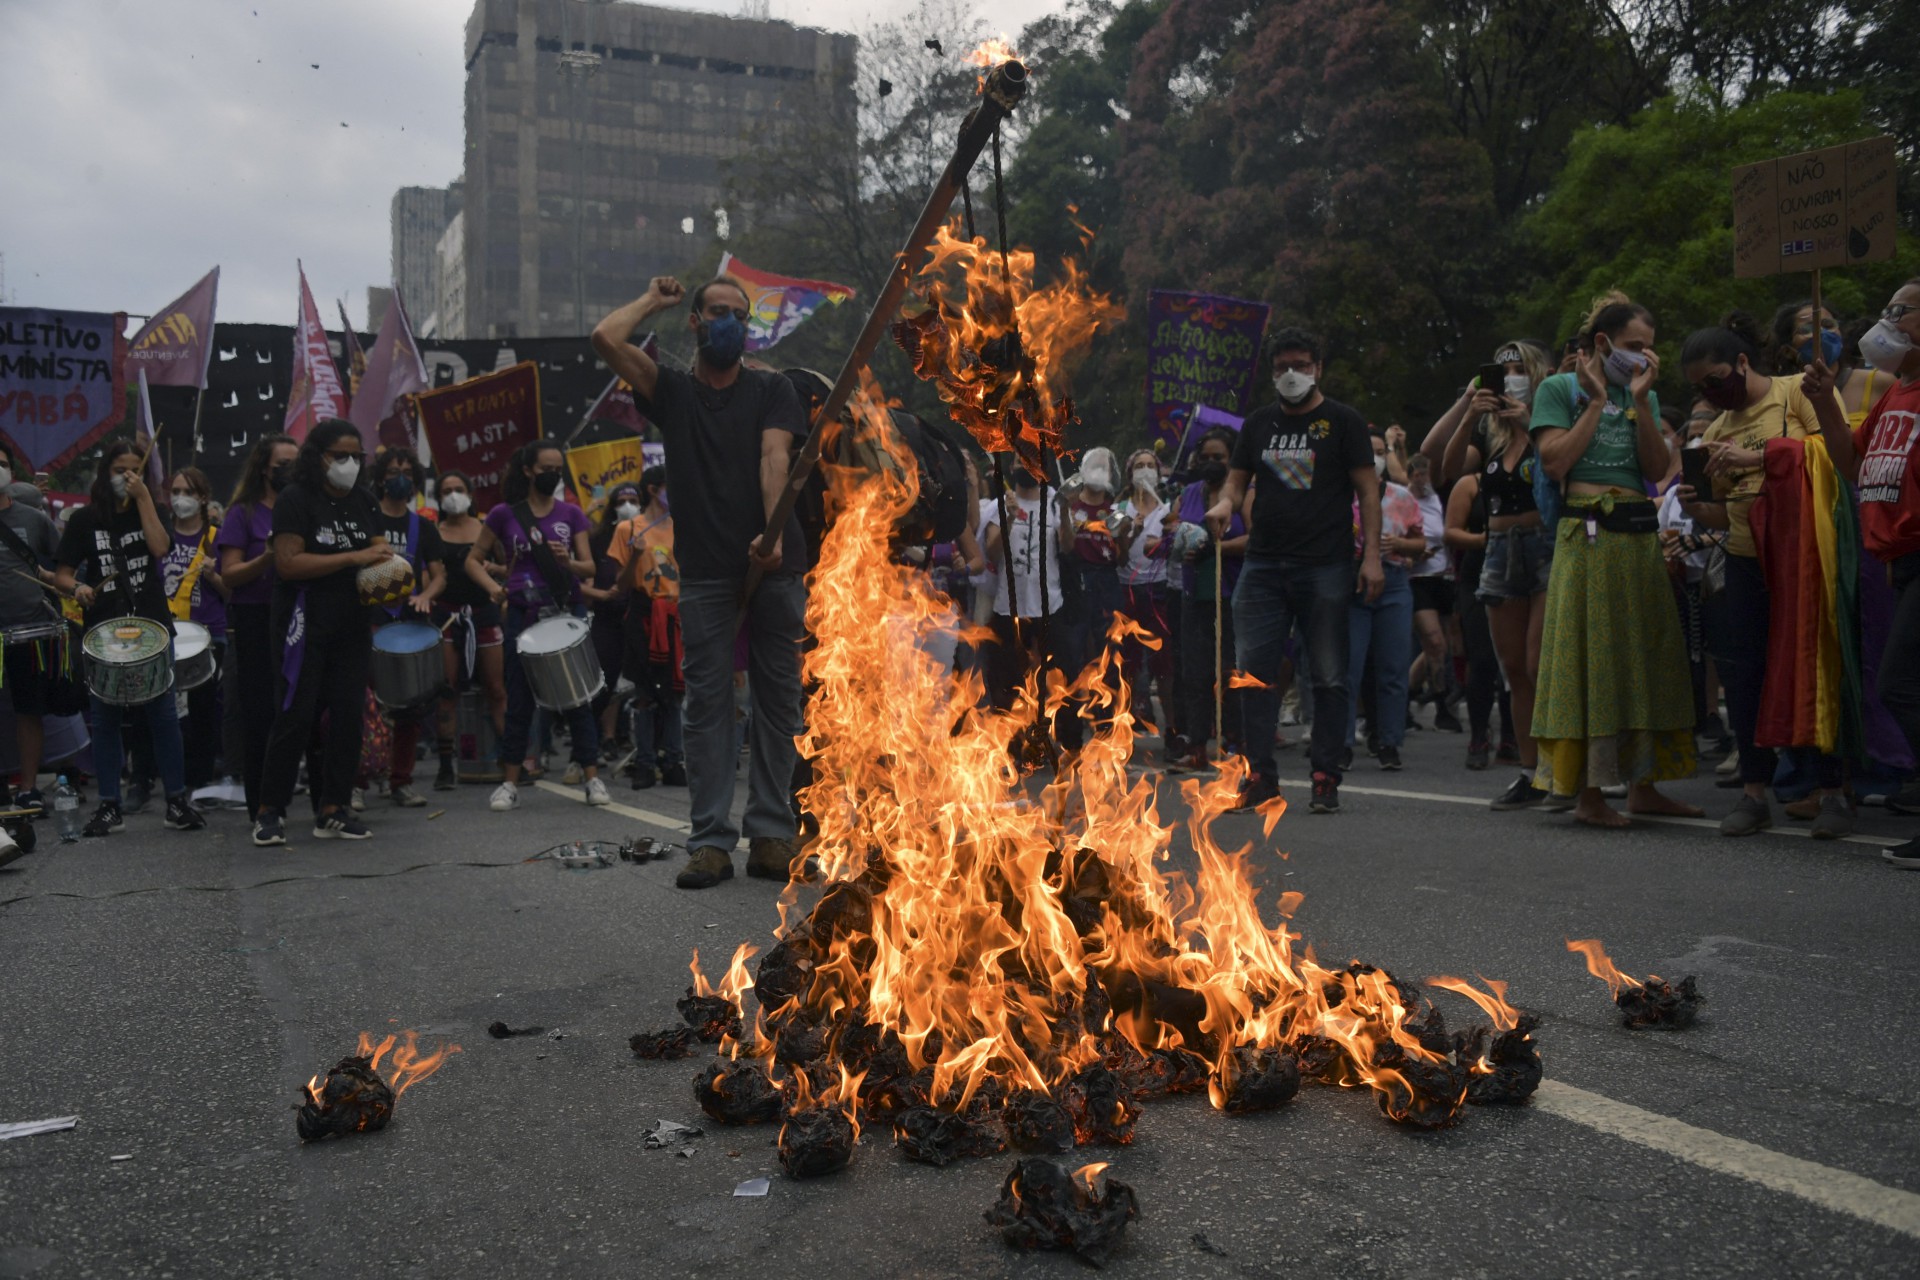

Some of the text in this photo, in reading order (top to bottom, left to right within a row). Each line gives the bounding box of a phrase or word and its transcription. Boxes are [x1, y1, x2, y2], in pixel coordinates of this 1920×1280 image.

[1788, 156, 1825, 186] NÃO
[1780, 188, 1841, 215] OUVIRAM
[1793, 213, 1839, 233] NOSSO
[1862, 211, 1884, 234] LUTO
[1782, 240, 1814, 256] ELE
[0, 317, 101, 352] LETIVO
[0, 349, 113, 383] MINISTA
[456, 419, 519, 453] BASTA
[1269, 433, 1307, 449] FORA
[1869, 414, 1914, 452] ORA
[384, 529, 408, 544] ORA
